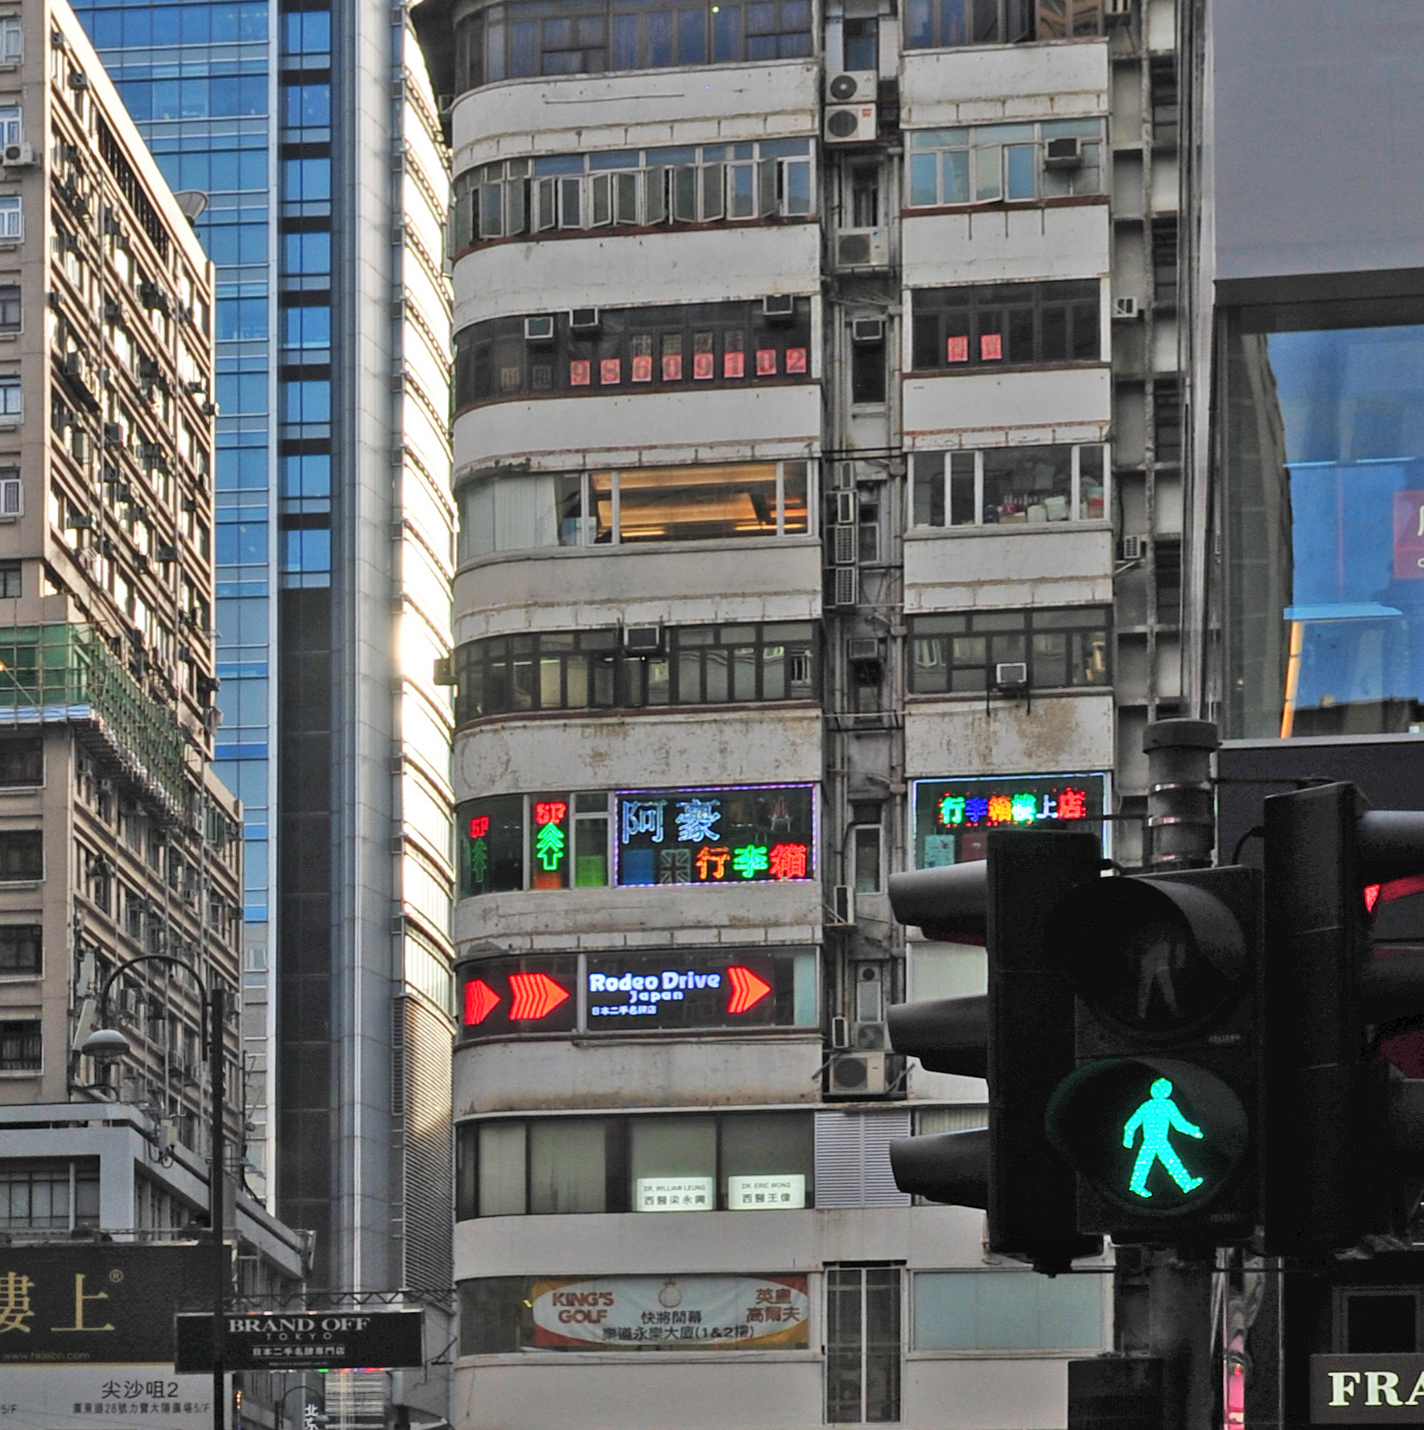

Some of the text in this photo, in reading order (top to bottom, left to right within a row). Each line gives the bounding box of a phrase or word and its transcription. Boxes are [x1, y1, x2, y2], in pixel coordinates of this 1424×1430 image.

[621, 798, 722, 843] 阿豪
[694, 842, 808, 880] 行李箱
[589, 971, 721, 992] Rodeo Drive
[629, 990, 684, 1003] Japan
[552, 1292, 615, 1307] KING'S
[756, 1288, 792, 1304] 英皇
[558, 1309, 608, 1324] GOLF
[746, 1306, 801, 1322] 高爾夫
[229, 1318, 370, 1333] BRAND OFF
[267, 1332, 332, 1341] TOKYO
[101, 1381, 178, 1399] 尖沙咀2
